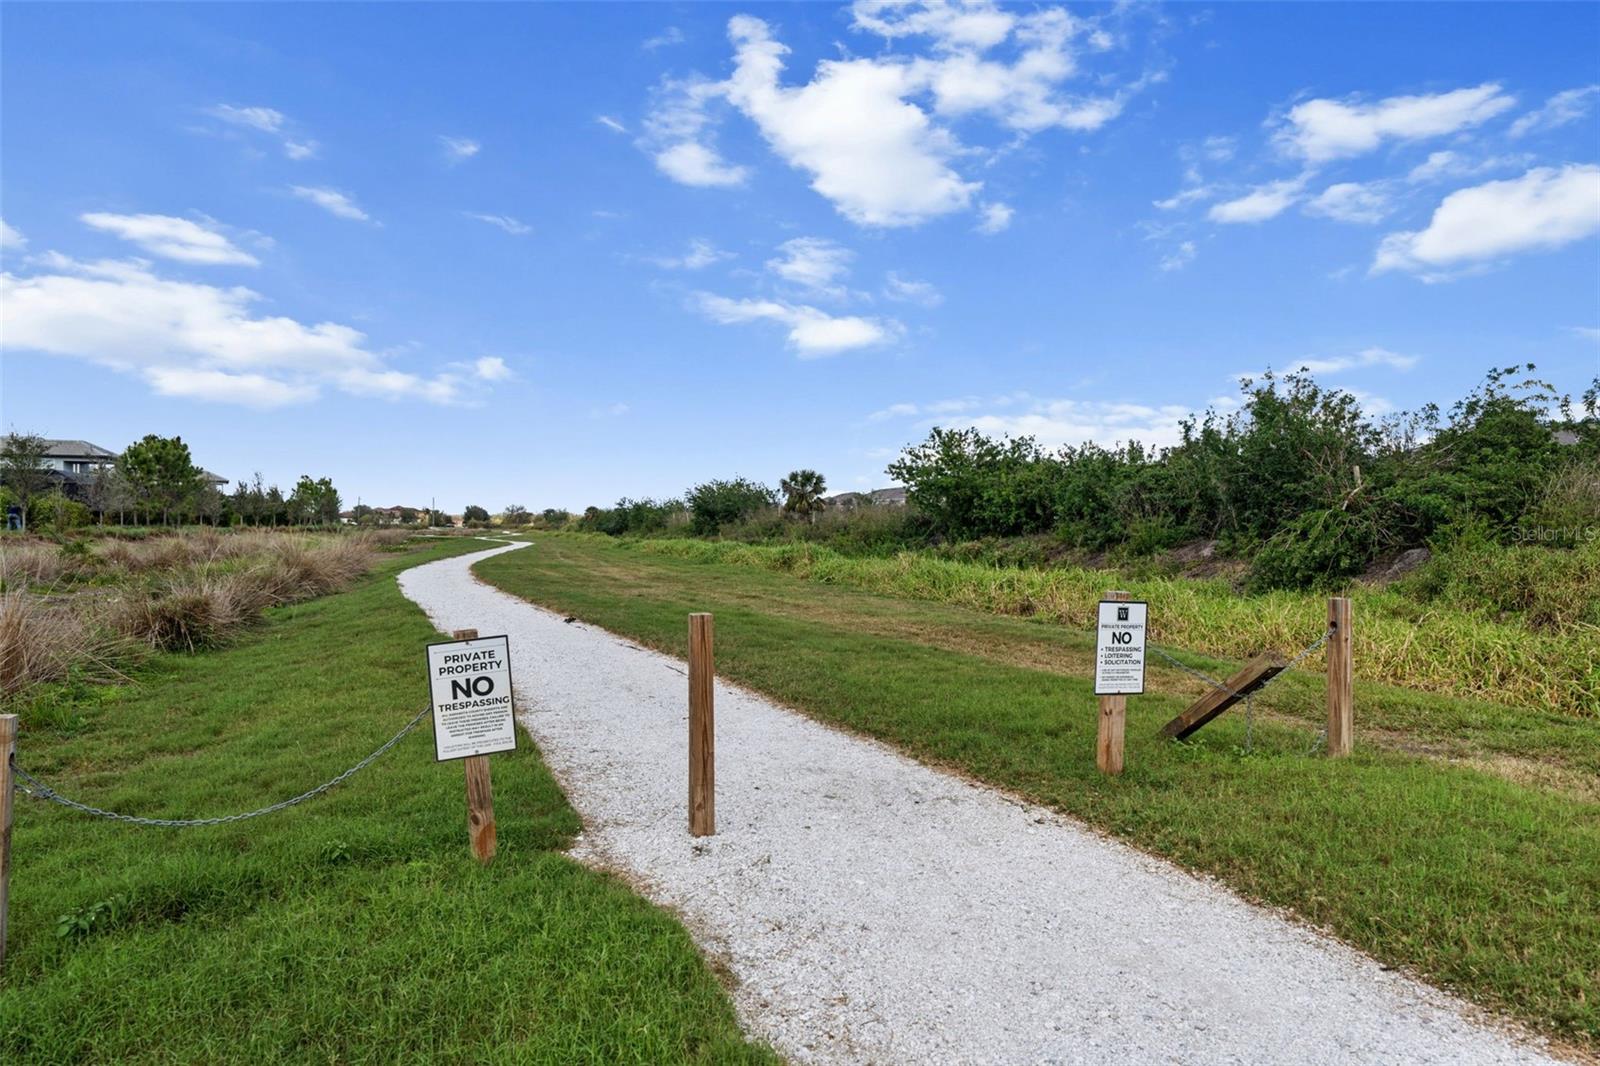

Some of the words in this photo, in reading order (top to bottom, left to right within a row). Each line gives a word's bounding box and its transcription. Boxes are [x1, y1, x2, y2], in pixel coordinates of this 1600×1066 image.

[1112, 631, 1132, 645] NO
[444, 649, 496, 664] PRIVATE
[438, 660, 502, 676] PROPERTY
[451, 675, 494, 700] NO
[438, 696, 510, 712] TRESPASSING
